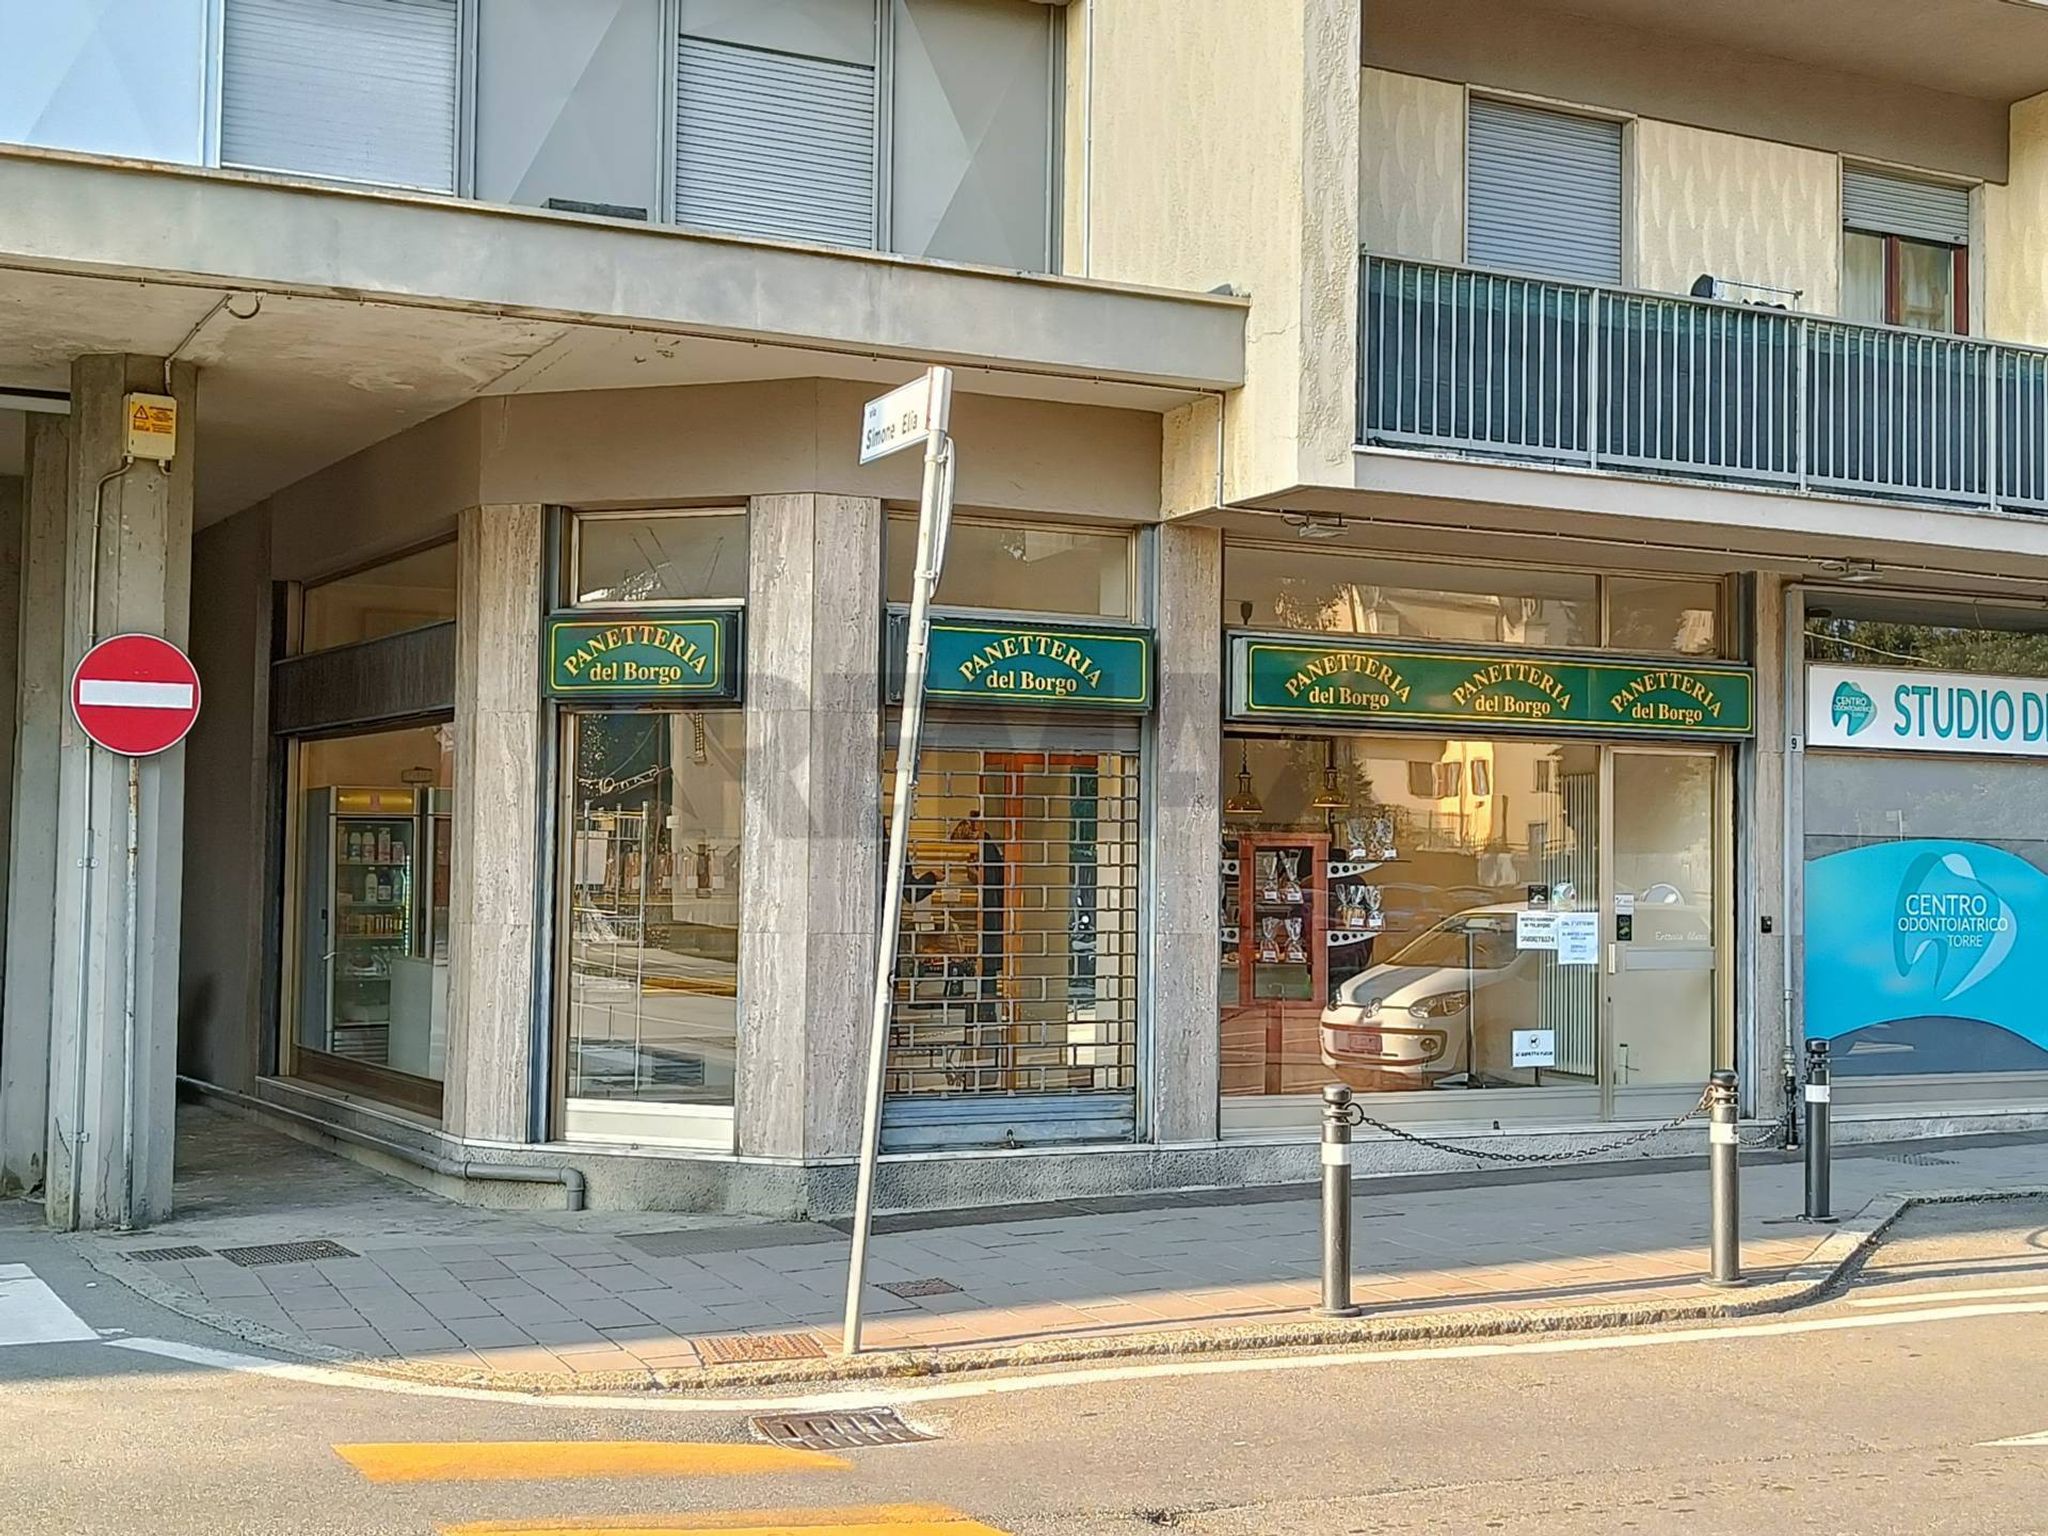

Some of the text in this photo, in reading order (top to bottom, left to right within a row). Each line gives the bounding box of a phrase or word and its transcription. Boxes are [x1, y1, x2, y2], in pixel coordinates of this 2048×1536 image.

[866, 410, 918, 449] Simone Elia
[563, 625, 708, 677] PANETTERIA
[958, 635, 1103, 688] PANETTERIA
[589, 661, 681, 684] del Borgo
[986, 670, 1078, 696] del Borgo
[1284, 653, 1413, 704] PANETTERIA
[1309, 686, 1390, 710] del Borgo
[1451, 663, 1572, 712] PANETTERIA
[1610, 671, 1723, 719] PANETTERIA
[1475, 694, 1551, 718] del Borgo
[1631, 702, 1703, 725] del Borgo
[1836, 696, 1867, 707] CENTRO
[1894, 684, 2048, 742] STUDIO D
[1791, 737, 1798, 750] 9
[1905, 894, 1987, 916] CENTRO
[1897, 917, 2008, 932] ODONTOIATRICO
[1947, 934, 1983, 948] TORRE
